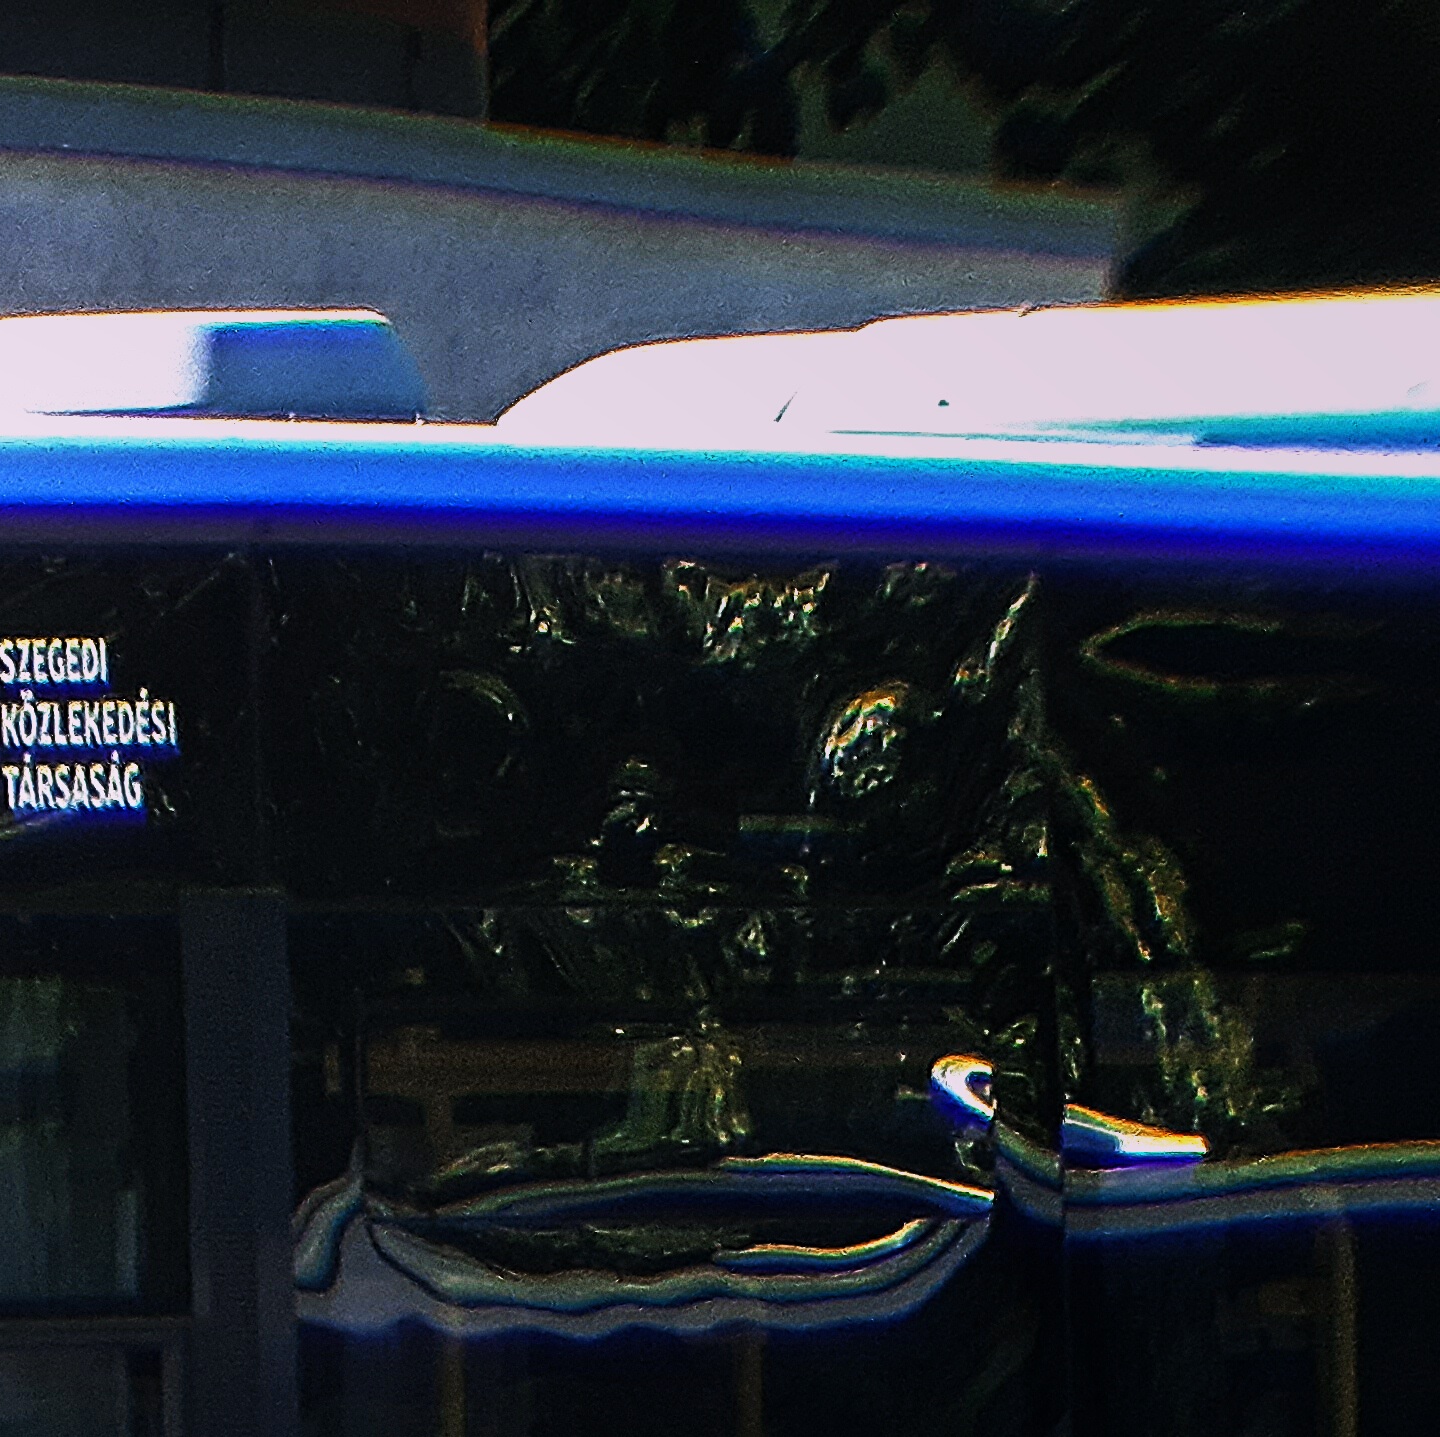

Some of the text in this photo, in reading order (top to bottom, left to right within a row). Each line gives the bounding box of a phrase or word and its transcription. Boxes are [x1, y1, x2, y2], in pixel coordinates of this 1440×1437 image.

[0, 636, 109, 685] SZEGEDI
[0, 687, 178, 748] KÖZLEKEDÉSI
[1, 750, 146, 811] TÁRSASÁG
